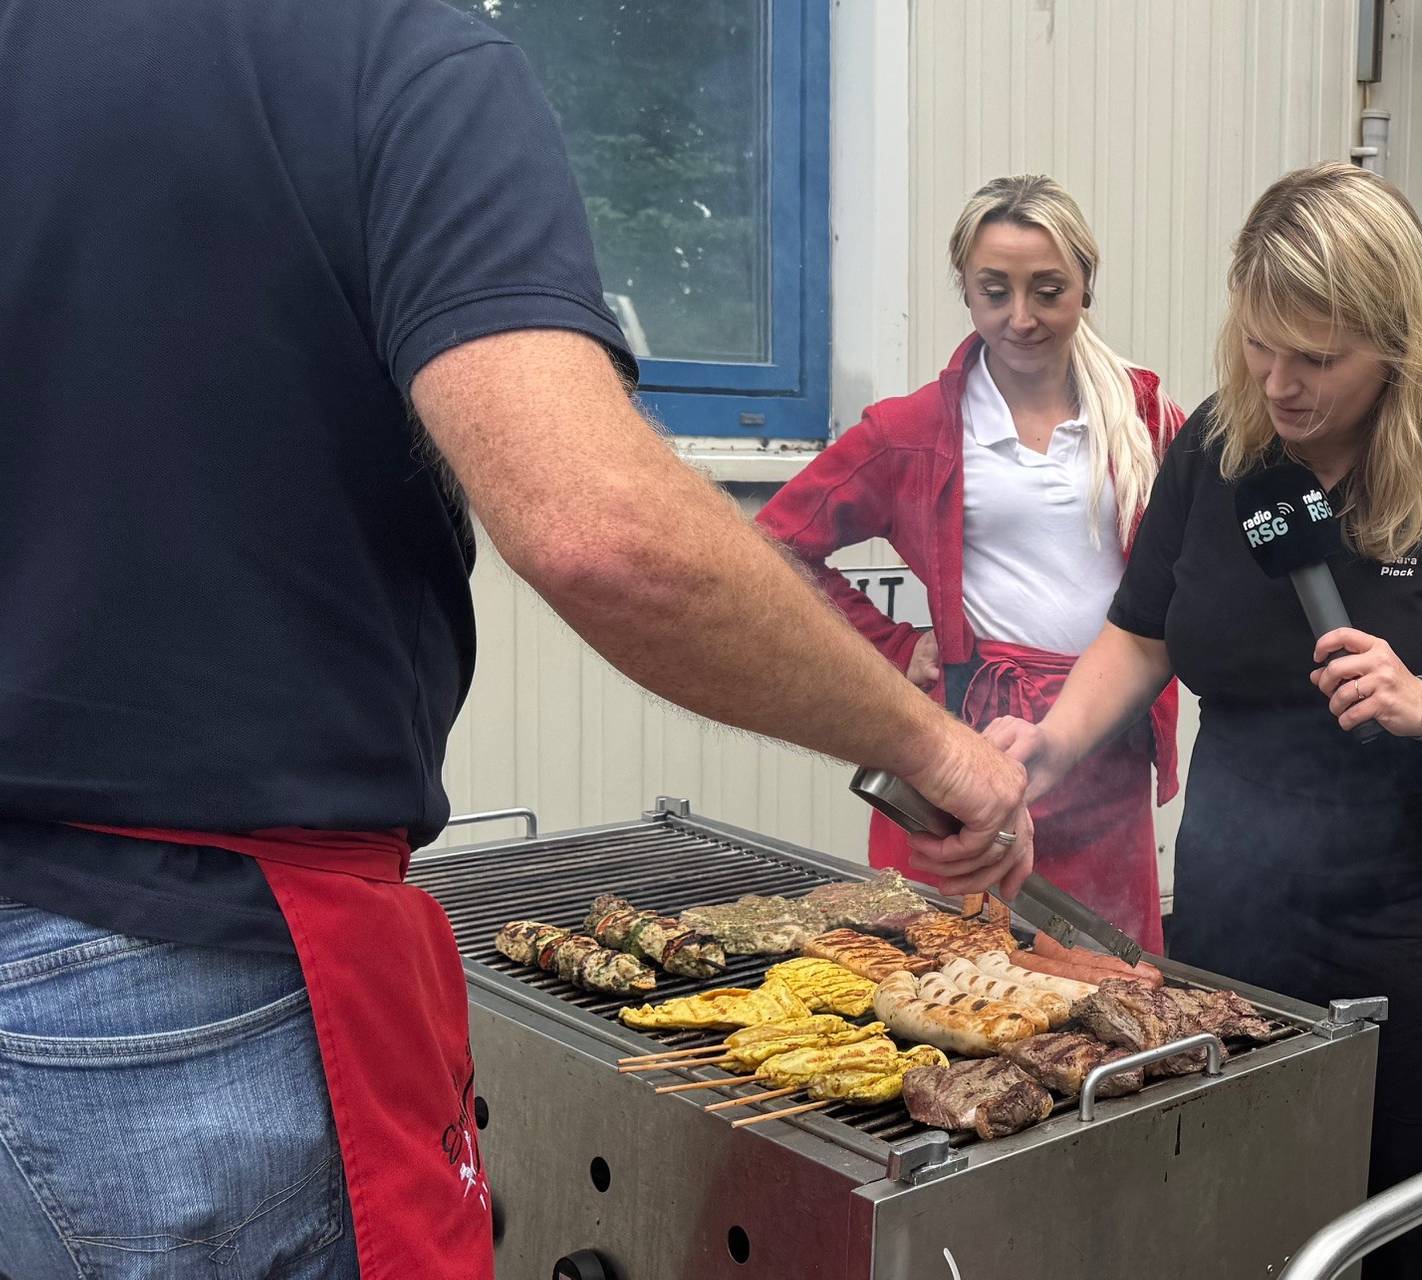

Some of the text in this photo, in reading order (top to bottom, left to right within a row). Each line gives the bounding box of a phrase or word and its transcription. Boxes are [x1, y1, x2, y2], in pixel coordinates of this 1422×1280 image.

[1242, 510, 1272, 531] radio
[1306, 500, 1333, 522] RSG
[1246, 516, 1289, 548] RSG
